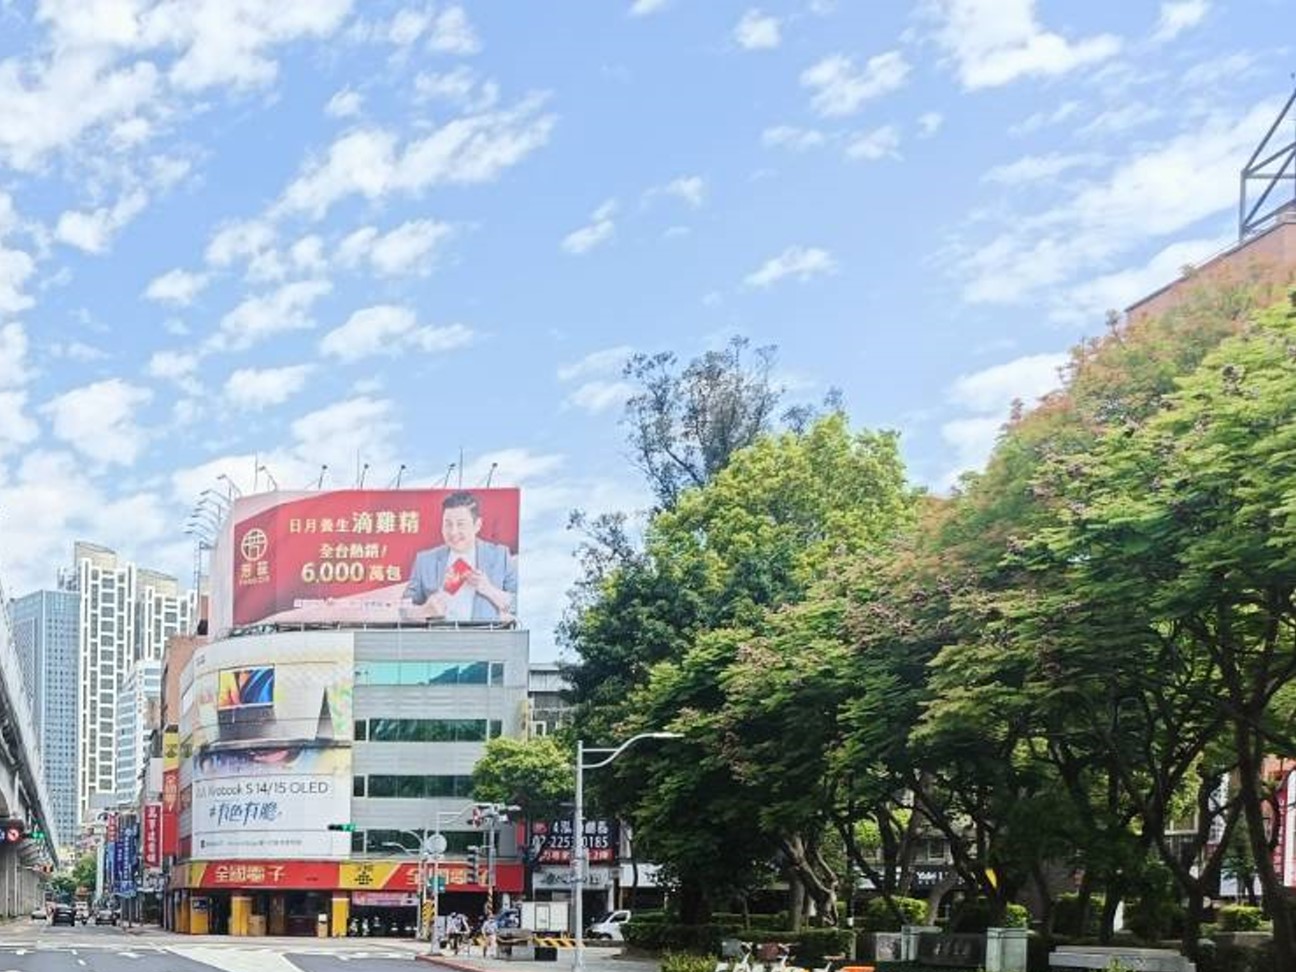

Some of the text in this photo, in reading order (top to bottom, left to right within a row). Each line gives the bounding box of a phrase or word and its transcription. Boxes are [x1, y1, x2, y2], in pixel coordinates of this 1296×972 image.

[290, 782, 328, 794] OLED
[214, 865, 285, 883] 全國電子
